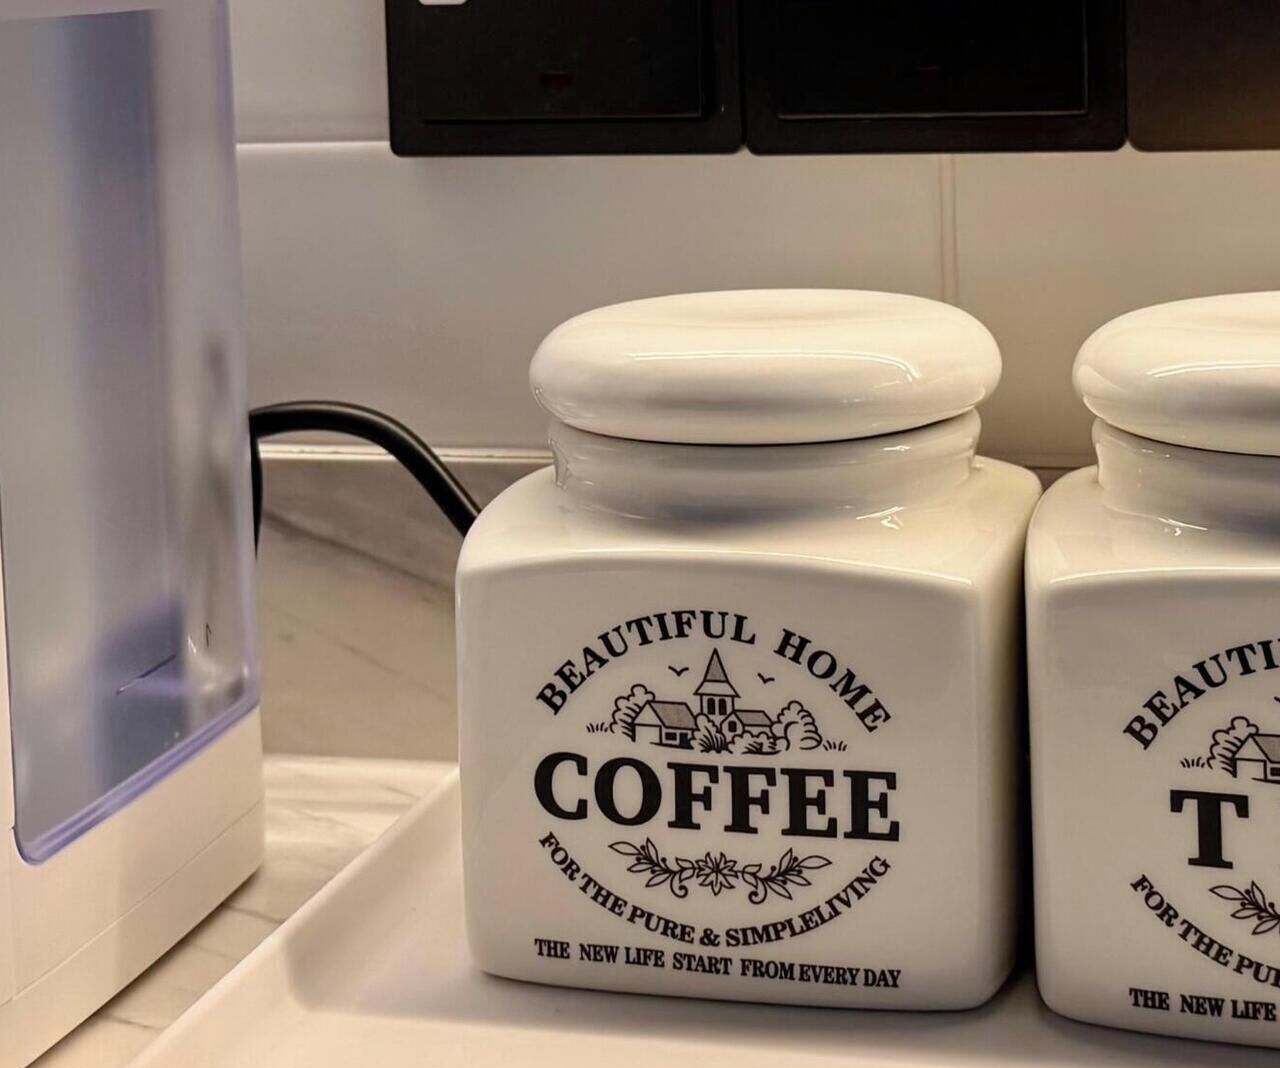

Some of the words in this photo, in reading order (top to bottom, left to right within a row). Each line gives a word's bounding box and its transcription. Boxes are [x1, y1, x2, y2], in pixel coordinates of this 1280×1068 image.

[536, 610, 757, 716] BEAUTIFUL
[773, 628, 892, 733] HOME
[534, 752, 900, 842] COFFEE
[539, 832, 578, 881] FOR
[578, 873, 628, 916] THE
[627, 905, 695, 944] PURE
[699, 928, 720, 946] &
[1130, 874, 1176, 928] FOR
[1177, 919, 1233, 967] THE
[534, 938, 570, 959] THE
[579, 943, 620, 964] NEW
[624, 946, 665, 968] LIFE
[672, 952, 733, 976] START
[740, 958, 795, 981] FROM
[799, 965, 860, 987] EVERY
[863, 968, 902, 988] DAY
[1129, 988, 1170, 1011] THE
[1180, 994, 1225, 1018] NEW
[1231, 999, 1277, 1022] LIFE
